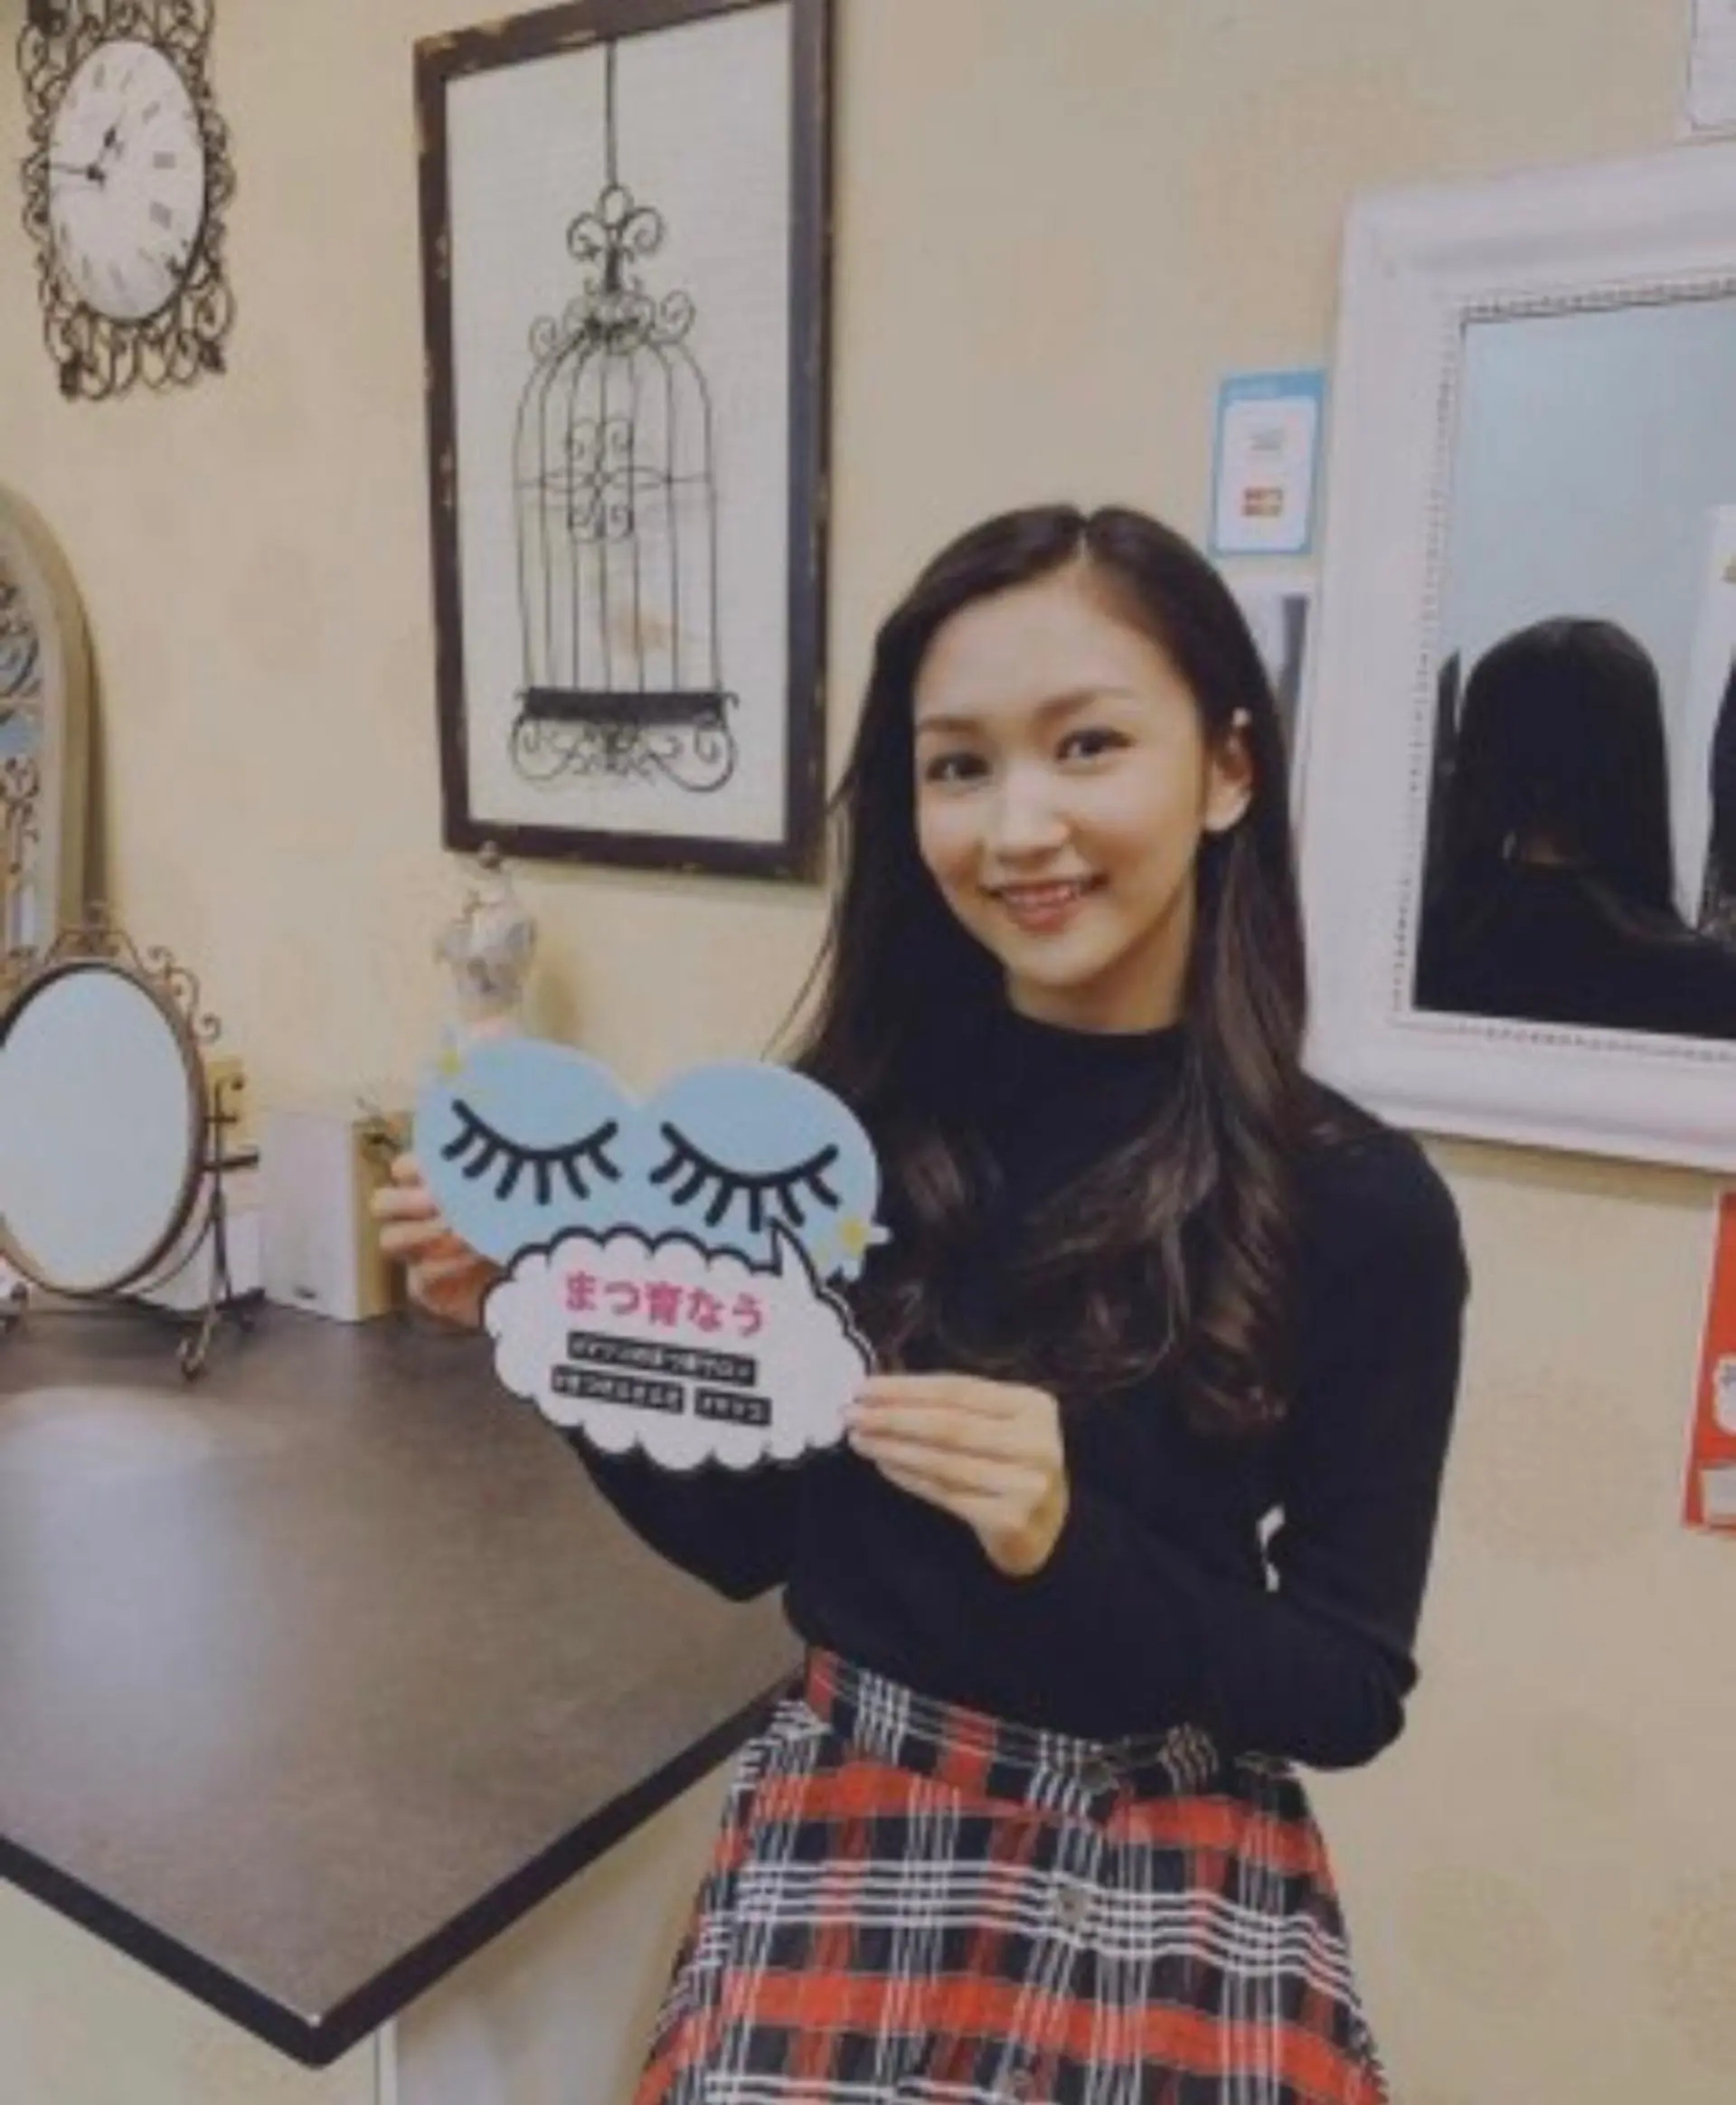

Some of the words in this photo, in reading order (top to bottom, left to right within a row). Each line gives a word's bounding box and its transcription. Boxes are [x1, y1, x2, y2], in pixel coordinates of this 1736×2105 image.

[566, 1270, 762, 1337] まつ育なう
